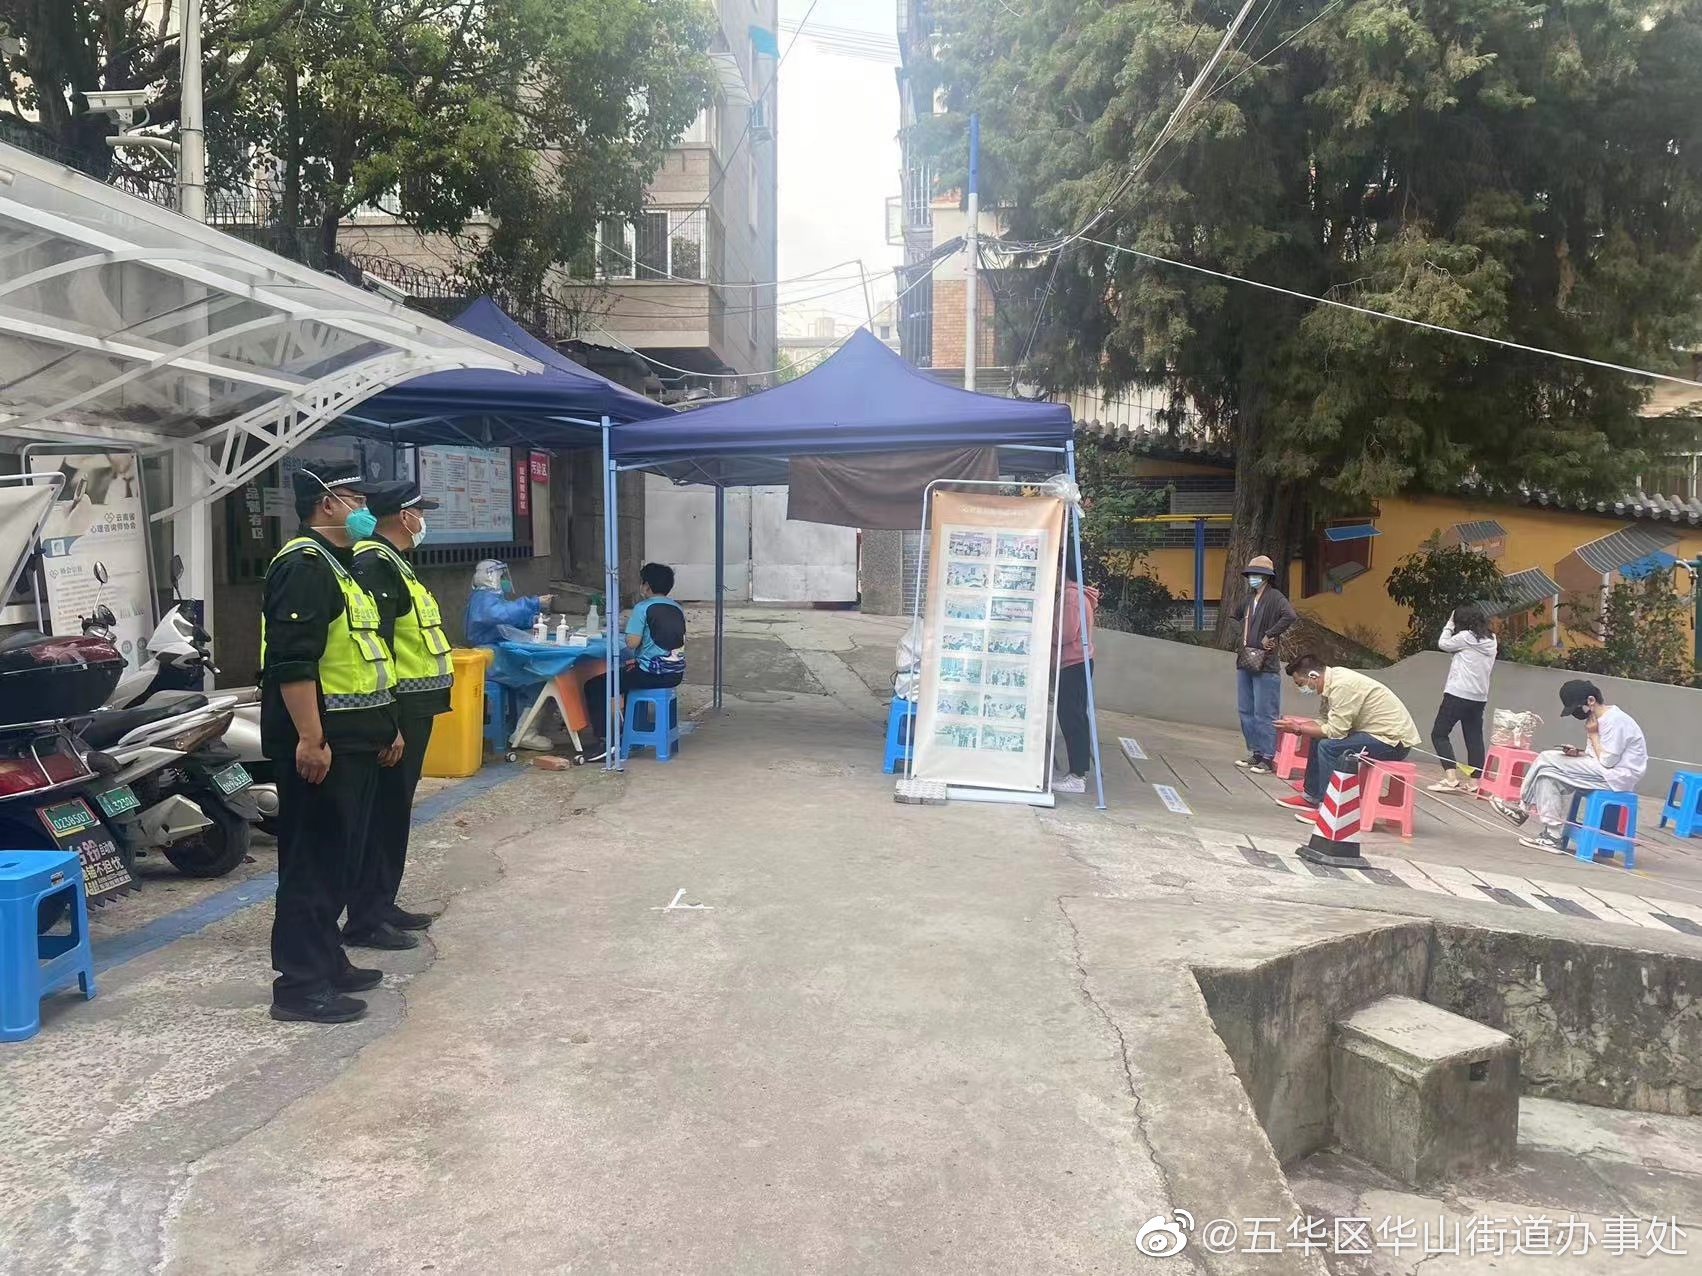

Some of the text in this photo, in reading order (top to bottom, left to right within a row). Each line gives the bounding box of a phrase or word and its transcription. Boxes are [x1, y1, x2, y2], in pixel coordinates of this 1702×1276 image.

[116, 512, 135, 521] 云南省
[90, 521, 137, 533] 心理咨询师协会
[53, 811, 90, 829] 0238507
